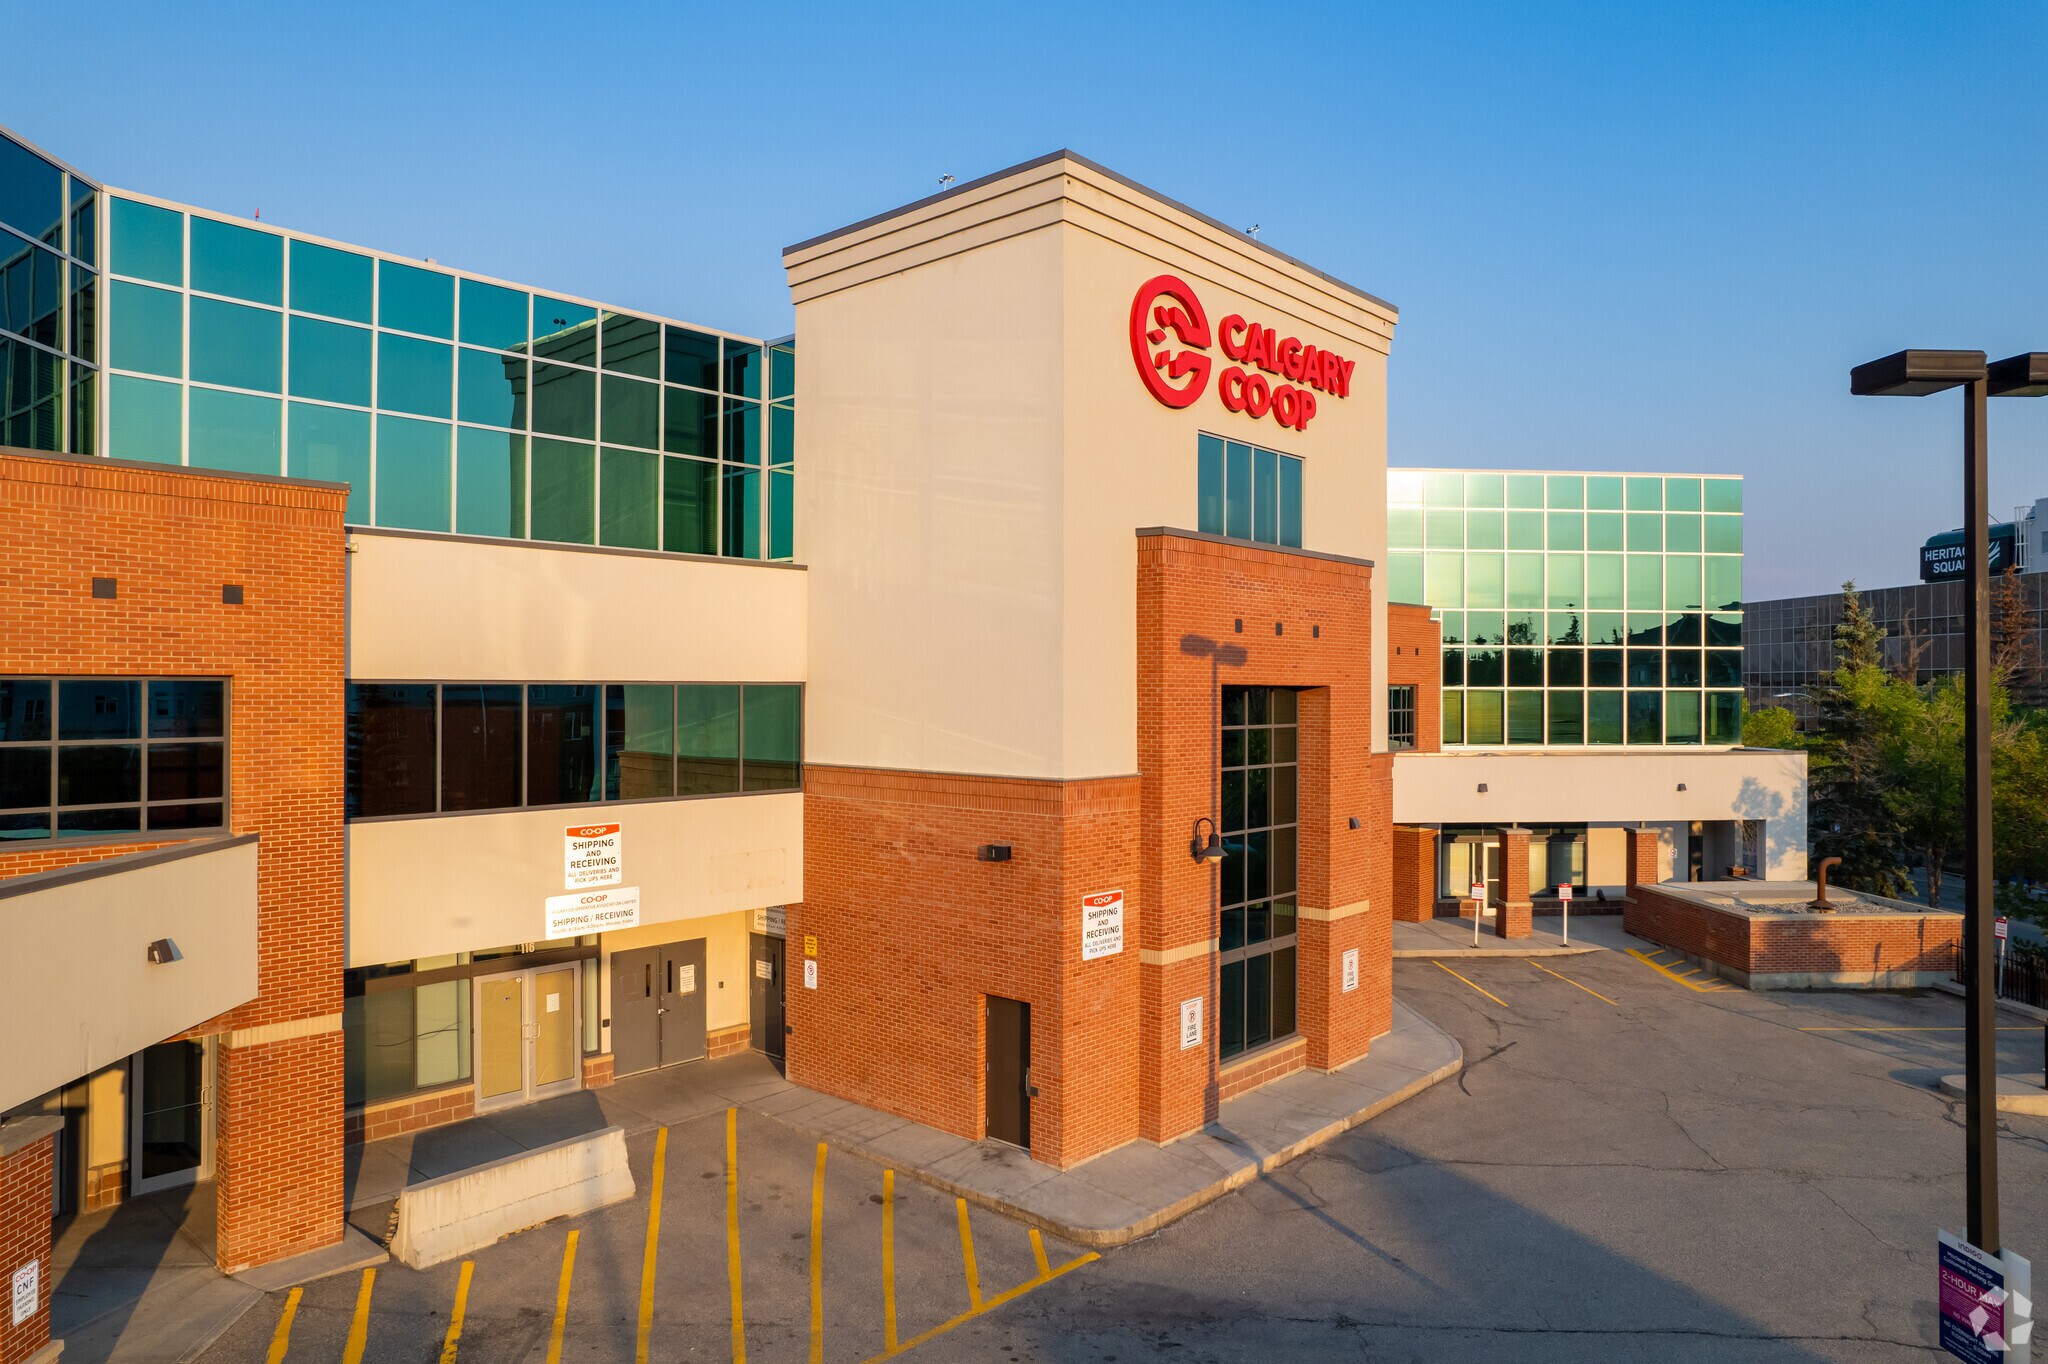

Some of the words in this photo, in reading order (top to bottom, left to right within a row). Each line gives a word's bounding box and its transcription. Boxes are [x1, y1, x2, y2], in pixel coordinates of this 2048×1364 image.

[1218, 314, 1355, 398] CALGARY
[1925, 546, 1965, 561] HERITA
[1933, 560, 1965, 573] SQUA
[580, 827, 607, 836] CO-OP
[572, 839, 614, 851] SHIPPING
[570, 857, 617, 869] RECEIVING
[579, 868, 607, 876] DELIVERIES
[580, 895, 608, 904] CO-OP
[1094, 896, 1113, 905] CO-OP
[553, 915, 589, 927] SHIPPING
[595, 909, 634, 921] RECEIVING
[1088, 907, 1118, 920] SHIPPING
[1098, 919, 1109, 927] AND
[1086, 925, 1119, 940] RECEIVING
[1186, 1030, 1197, 1039] LANE
[16, 1265, 37, 1283] CO-OP
[17, 1276, 34, 1295] CNF
[1942, 1270, 1977, 1297] 2-HOUR
[20, 1306, 31, 1317] ONLY
